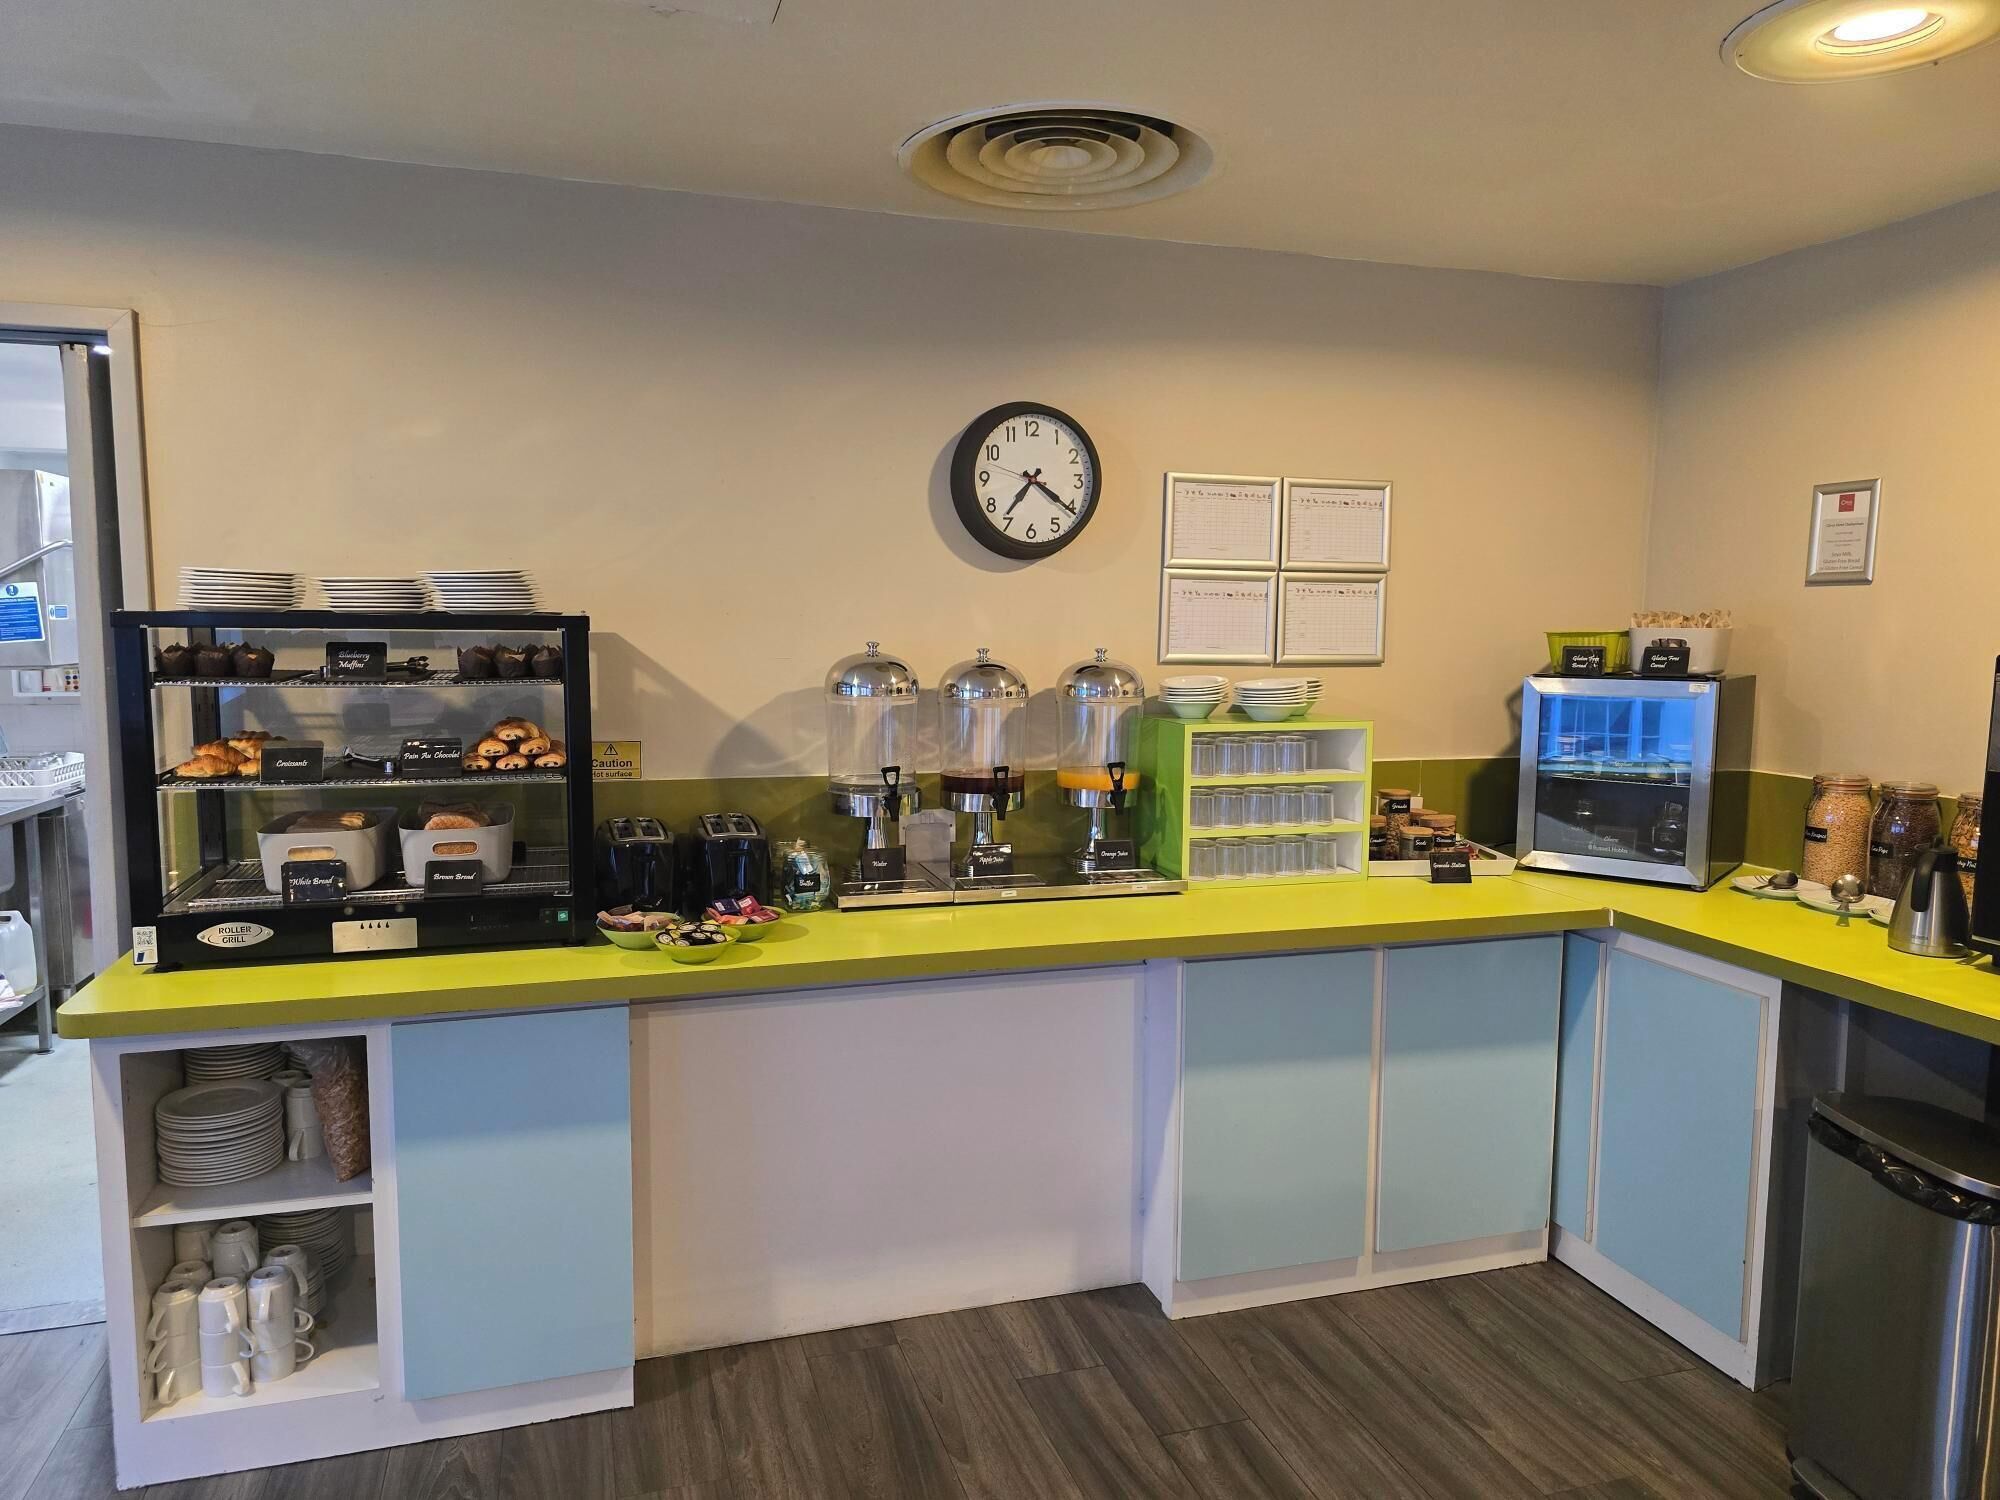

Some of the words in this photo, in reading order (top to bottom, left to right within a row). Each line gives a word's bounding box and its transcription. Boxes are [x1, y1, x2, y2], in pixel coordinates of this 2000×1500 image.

[1006, 426, 1016, 442] 11
[1025, 421, 1040, 437] 12
[986, 444, 1000, 461] 10
[1069, 448, 1079, 464] 2
[979, 471, 990, 487] 9
[1073, 474, 1083, 489] 3
[986, 497, 996, 513] 8
[1066, 499, 1076, 514] 4
[1003, 517, 1013, 532] 7
[1026, 523, 1036, 539] 6
[1050, 518, 1060, 533] 5
[339, 650, 370, 661] Blueberry
[339, 660, 364, 669] Muffins
[592, 759, 633, 768] Caution
[979, 856, 992, 865] Apple
[1101, 850, 1117, 859] Orange
[292, 877, 311, 886] White
[312, 875, 335, 884] Bread
[455, 871, 477, 880] Bread
[218, 925, 252, 934] ROLLER
[222, 936, 246, 944] GRILL
